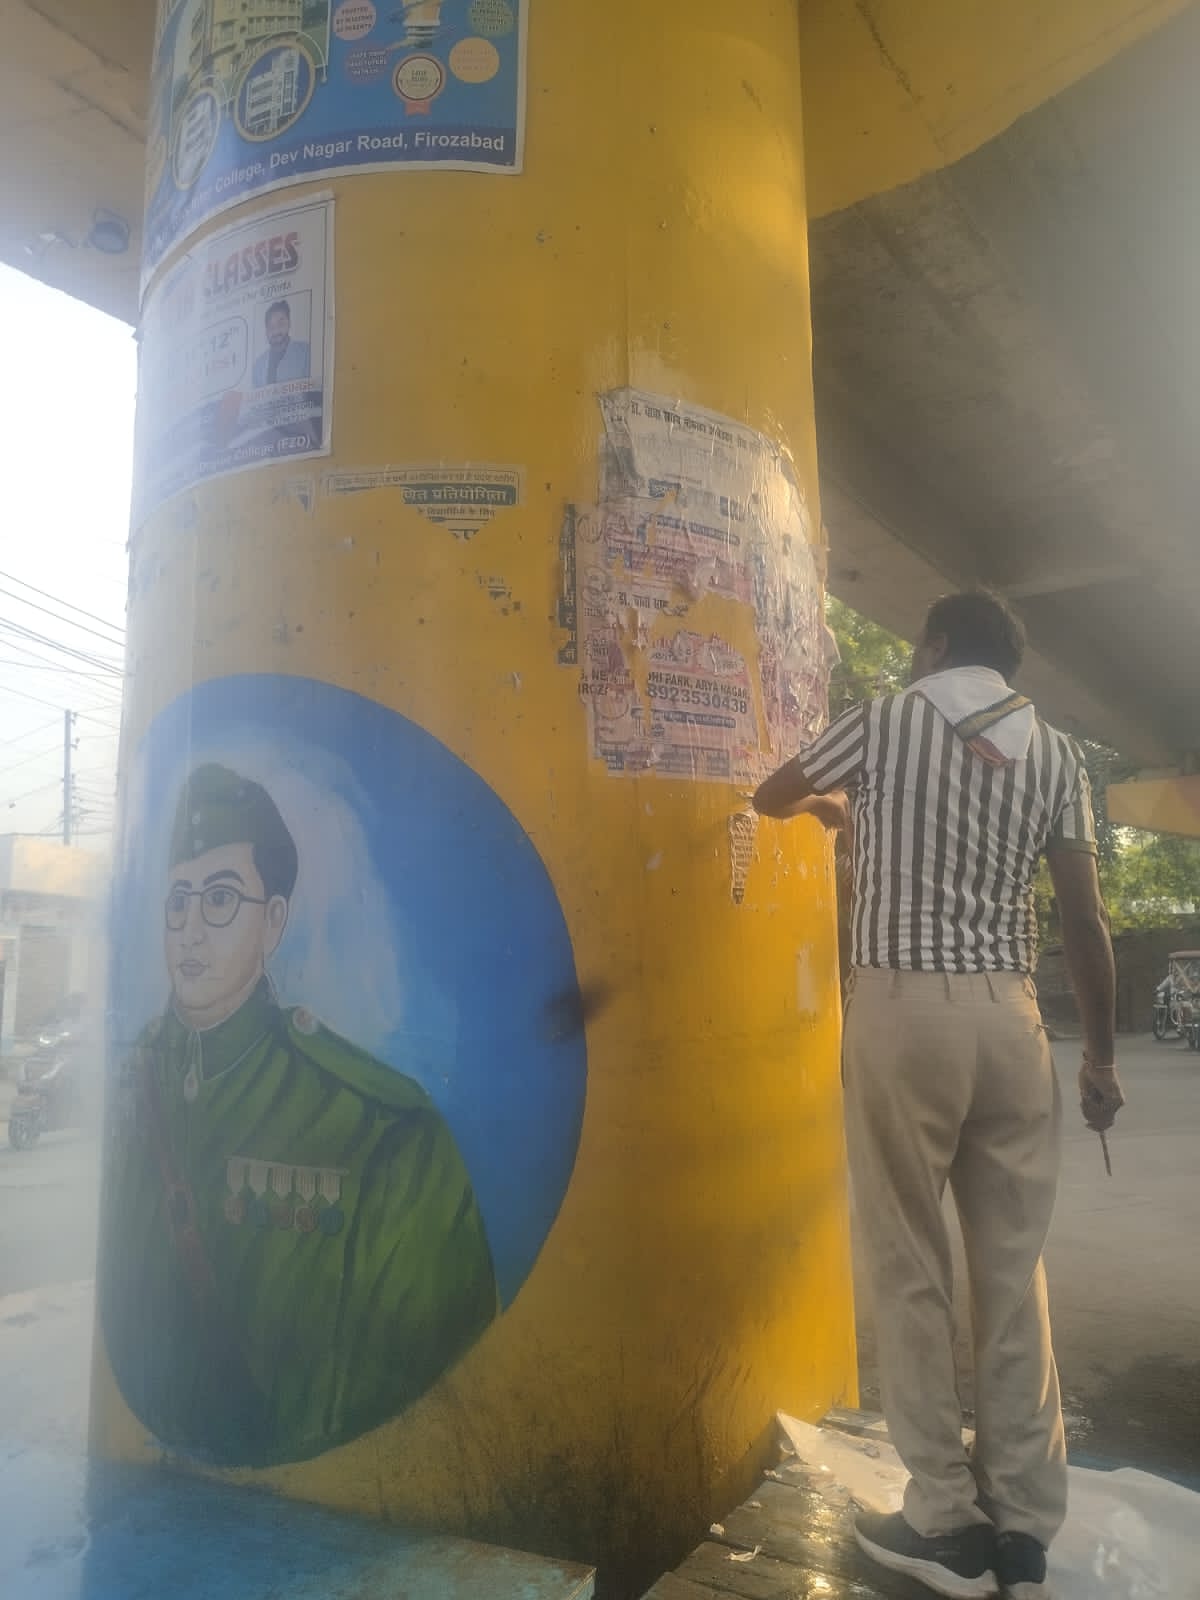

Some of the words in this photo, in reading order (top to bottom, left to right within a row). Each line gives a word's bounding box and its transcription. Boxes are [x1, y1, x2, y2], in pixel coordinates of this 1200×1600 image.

[270, 147, 298, 169] Dev
[303, 137, 353, 161] Nagar
[357, 132, 408, 152] Road,
[414, 131, 505, 152] Firozabad
